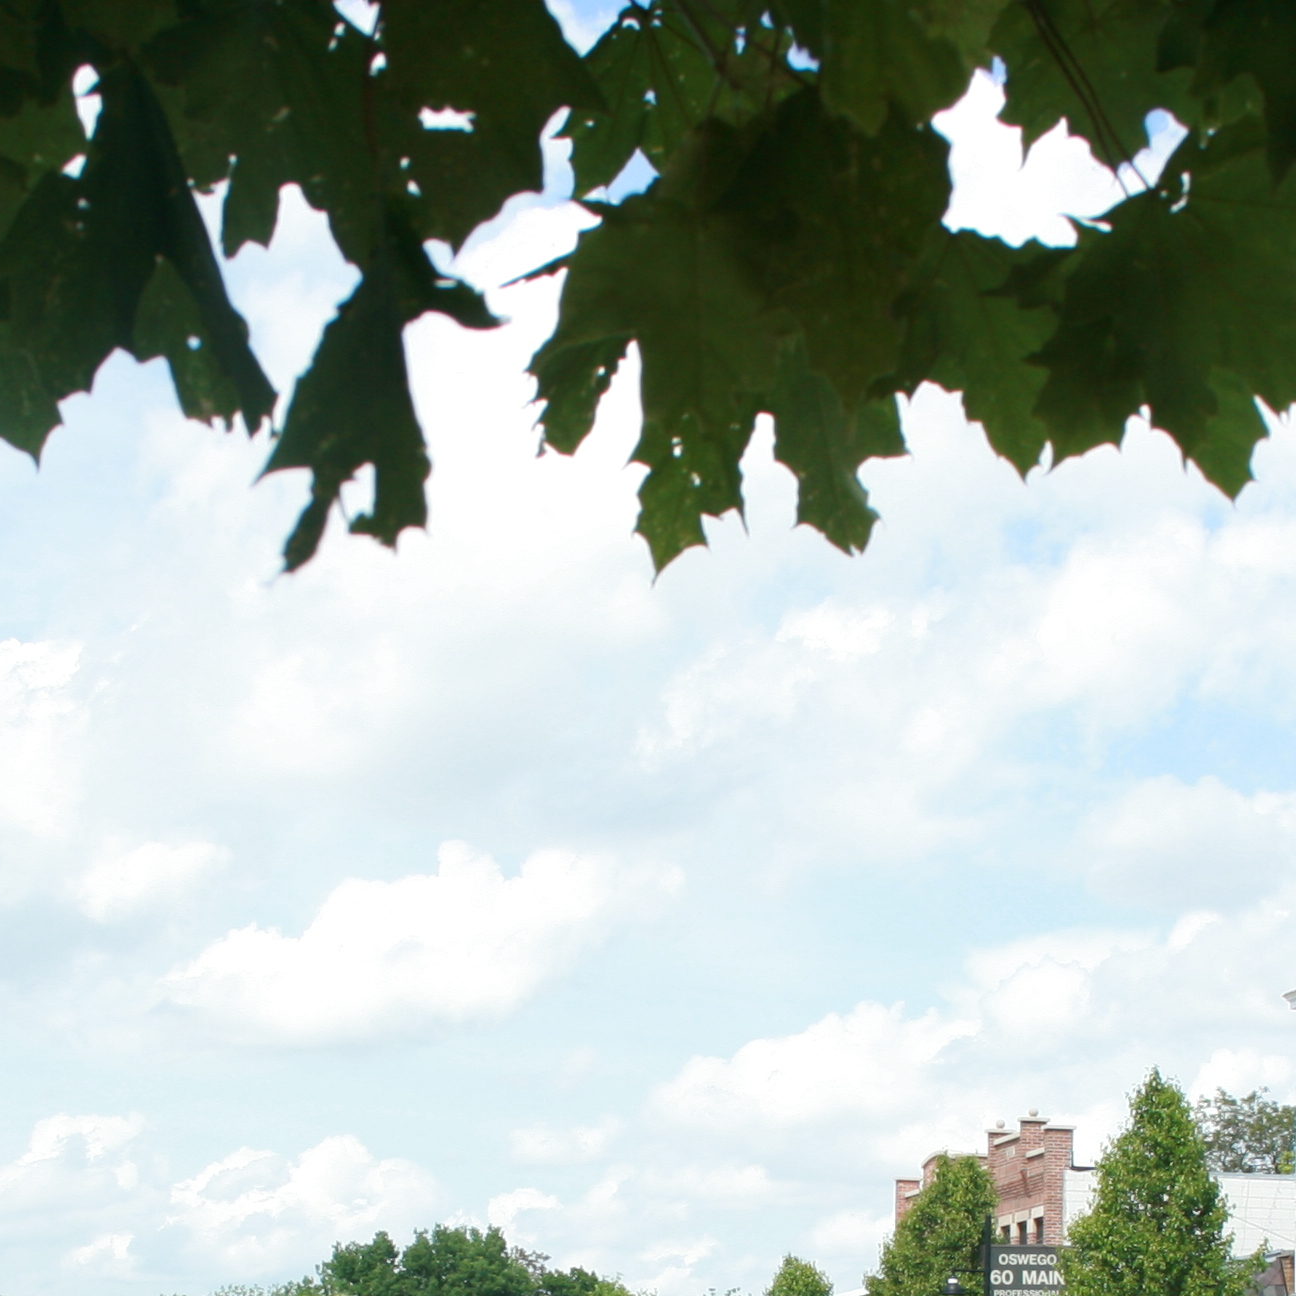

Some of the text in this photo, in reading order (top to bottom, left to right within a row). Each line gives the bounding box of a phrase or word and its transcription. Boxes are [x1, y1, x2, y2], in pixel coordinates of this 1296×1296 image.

[998, 1253, 1057, 1266] OSWEGO
[990, 1269, 1066, 1286] 60 MAIN
